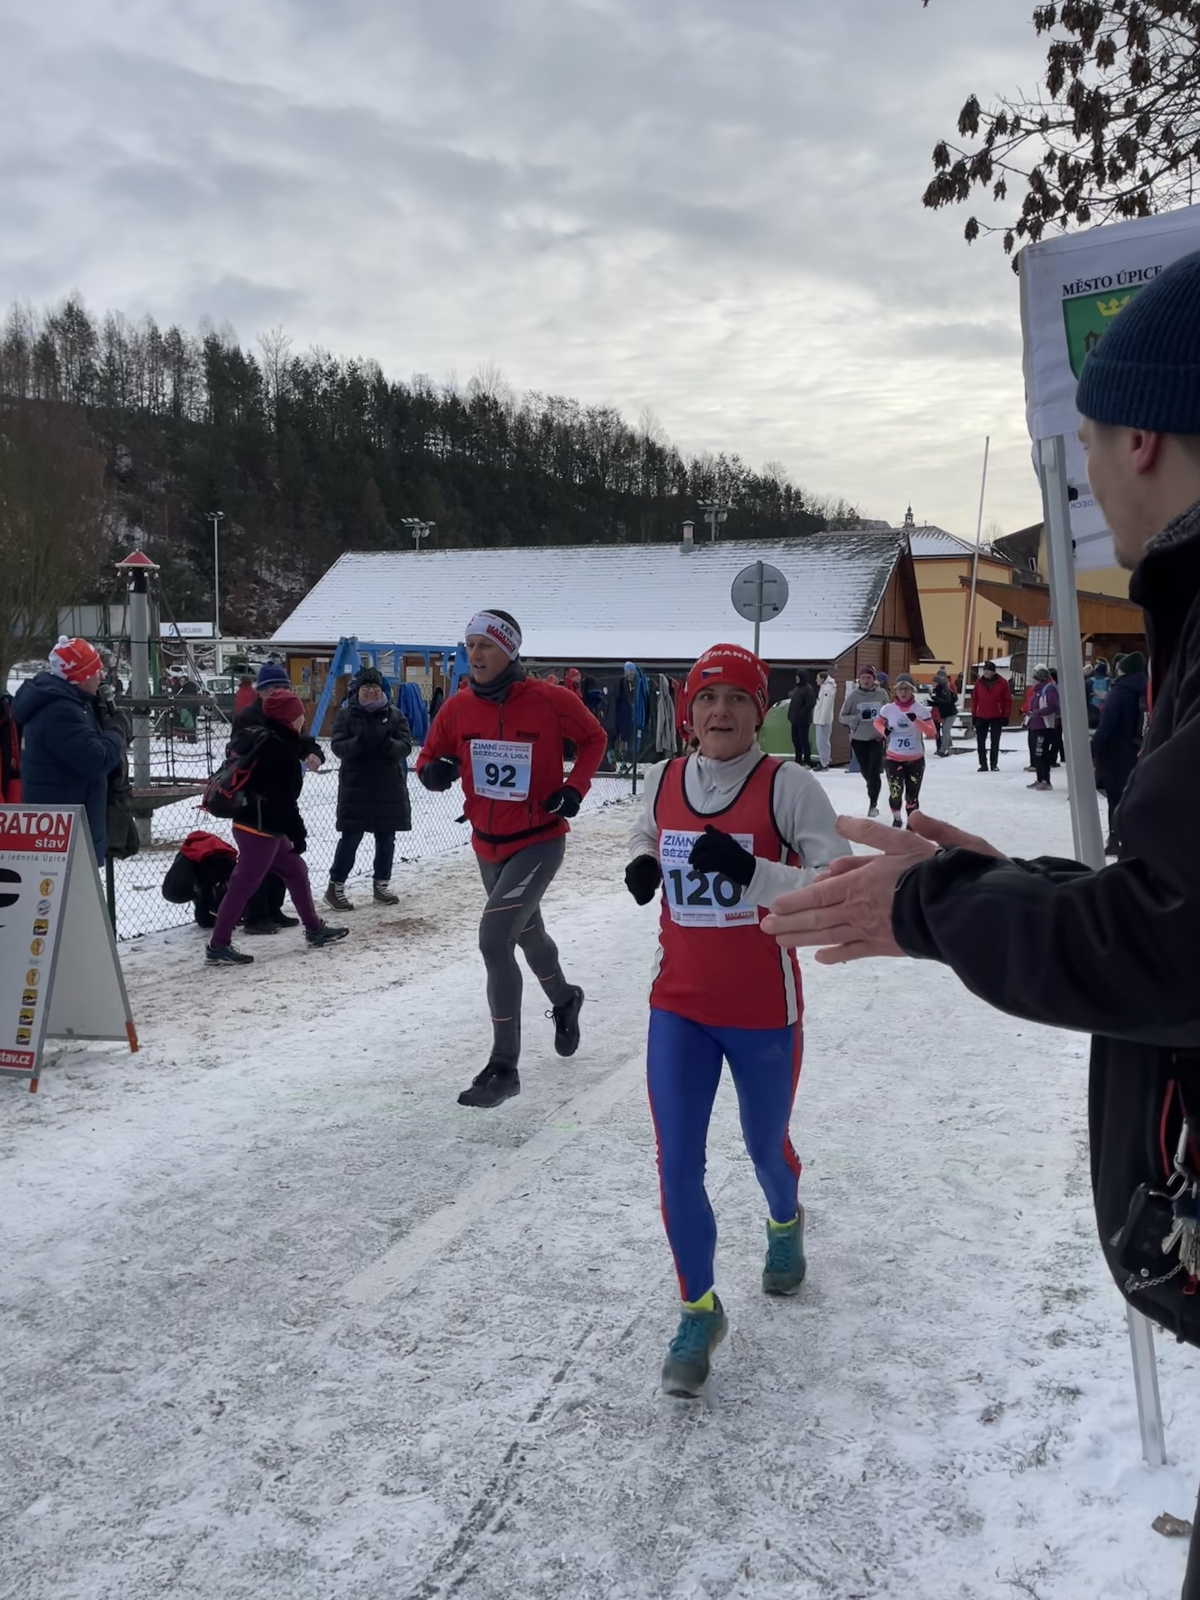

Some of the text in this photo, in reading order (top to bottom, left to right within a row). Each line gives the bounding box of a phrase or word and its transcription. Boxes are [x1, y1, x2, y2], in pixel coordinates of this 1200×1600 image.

[1062, 275, 1113, 297] MĚSTO
[897, 738, 911, 748] 76
[485, 763, 516, 788] 92
[34, 838, 65, 848] stav
[663, 835, 702, 848] ZIMN
[668, 868, 743, 908] 120
